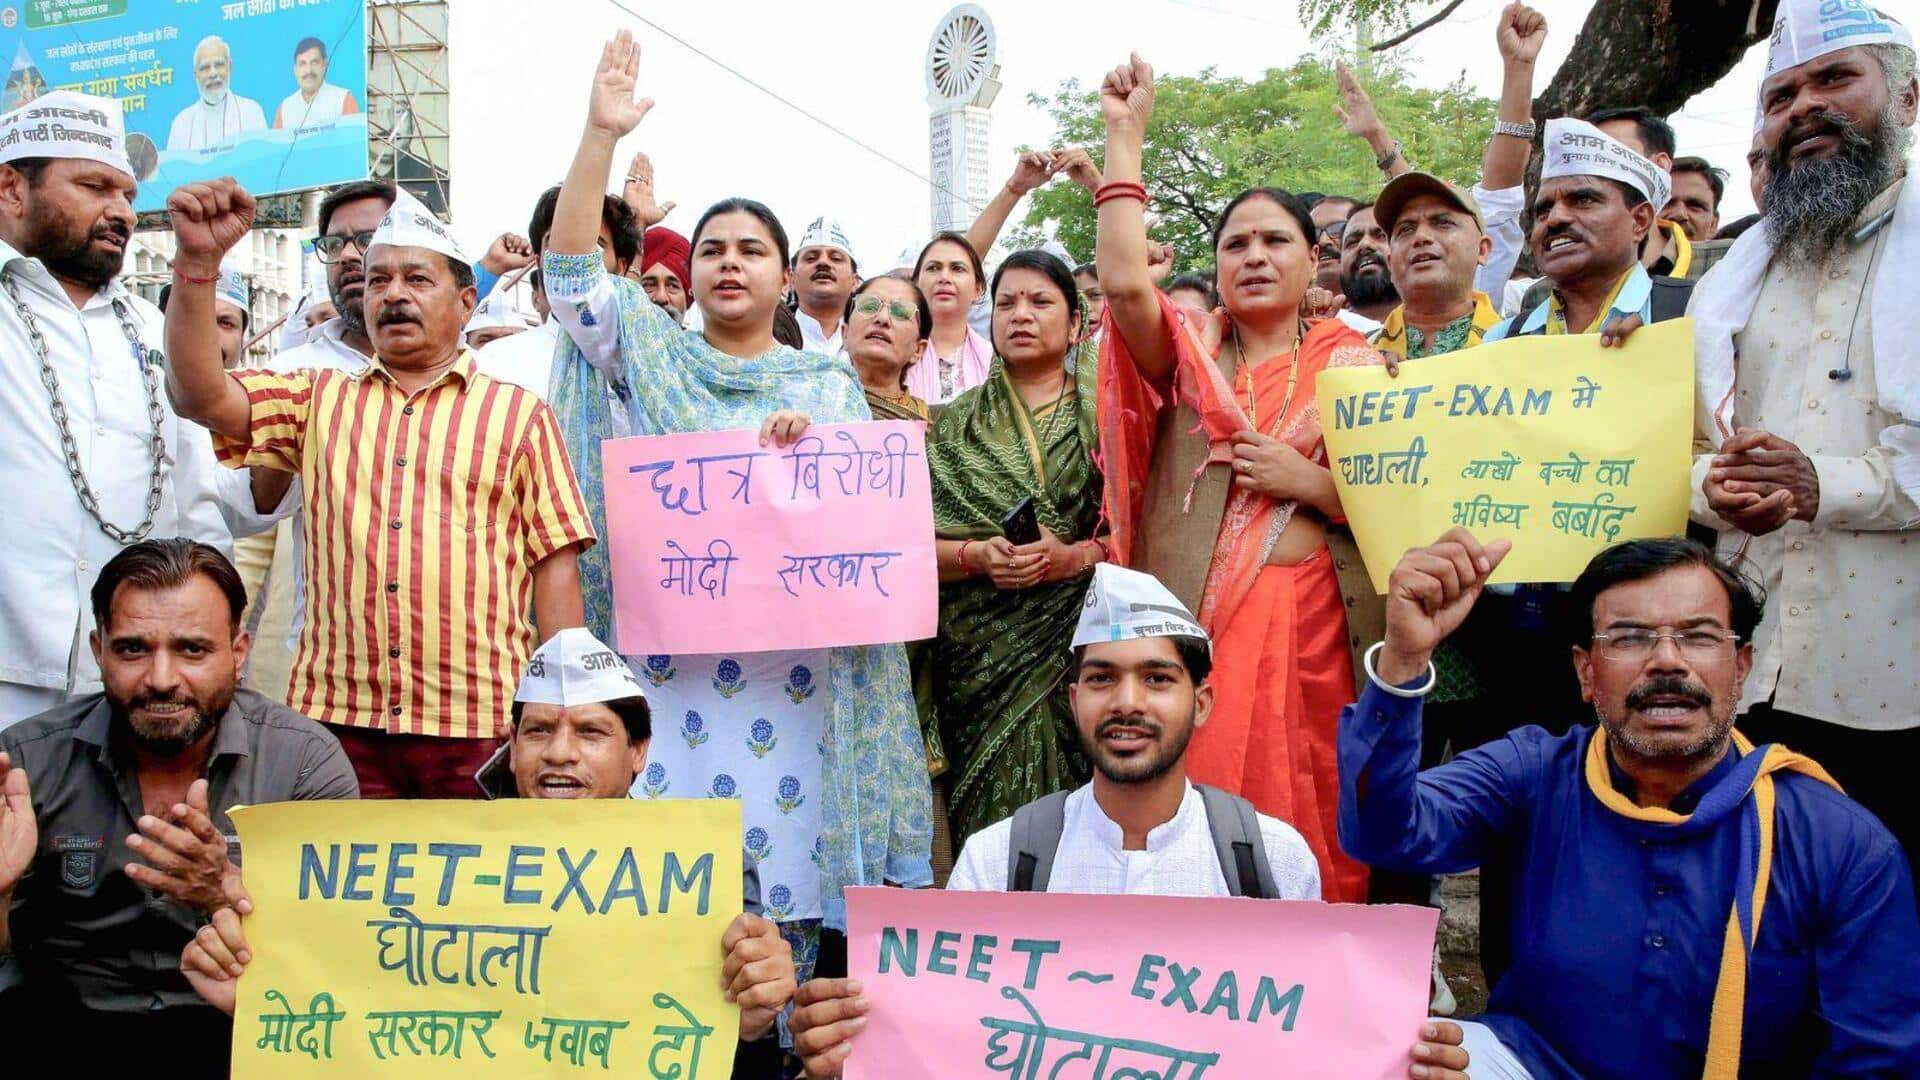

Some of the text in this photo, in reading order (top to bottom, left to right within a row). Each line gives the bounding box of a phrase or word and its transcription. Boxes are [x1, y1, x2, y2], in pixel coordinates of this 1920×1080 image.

[23, 123, 49, 142] पार्टी
[26, 107, 108, 128] आदमी
[1560, 131, 1606, 151] आम
[1571, 376, 1602, 409] में
[1461, 451, 1522, 481] लाखों
[1596, 459, 1636, 487] का
[1452, 492, 1637, 542] भविष्य बर्बाद
[660, 539, 902, 600] मोदी सरकार
[581, 650, 618, 671] आम
[298, 842, 715, 917] NEET-EXAM
[366, 907, 552, 995] घोटाला
[878, 926, 1061, 990] NEET
[1131, 953, 1305, 1032] EXAM
[256, 990, 714, 1080] मोदी सरकार जवाब दो
